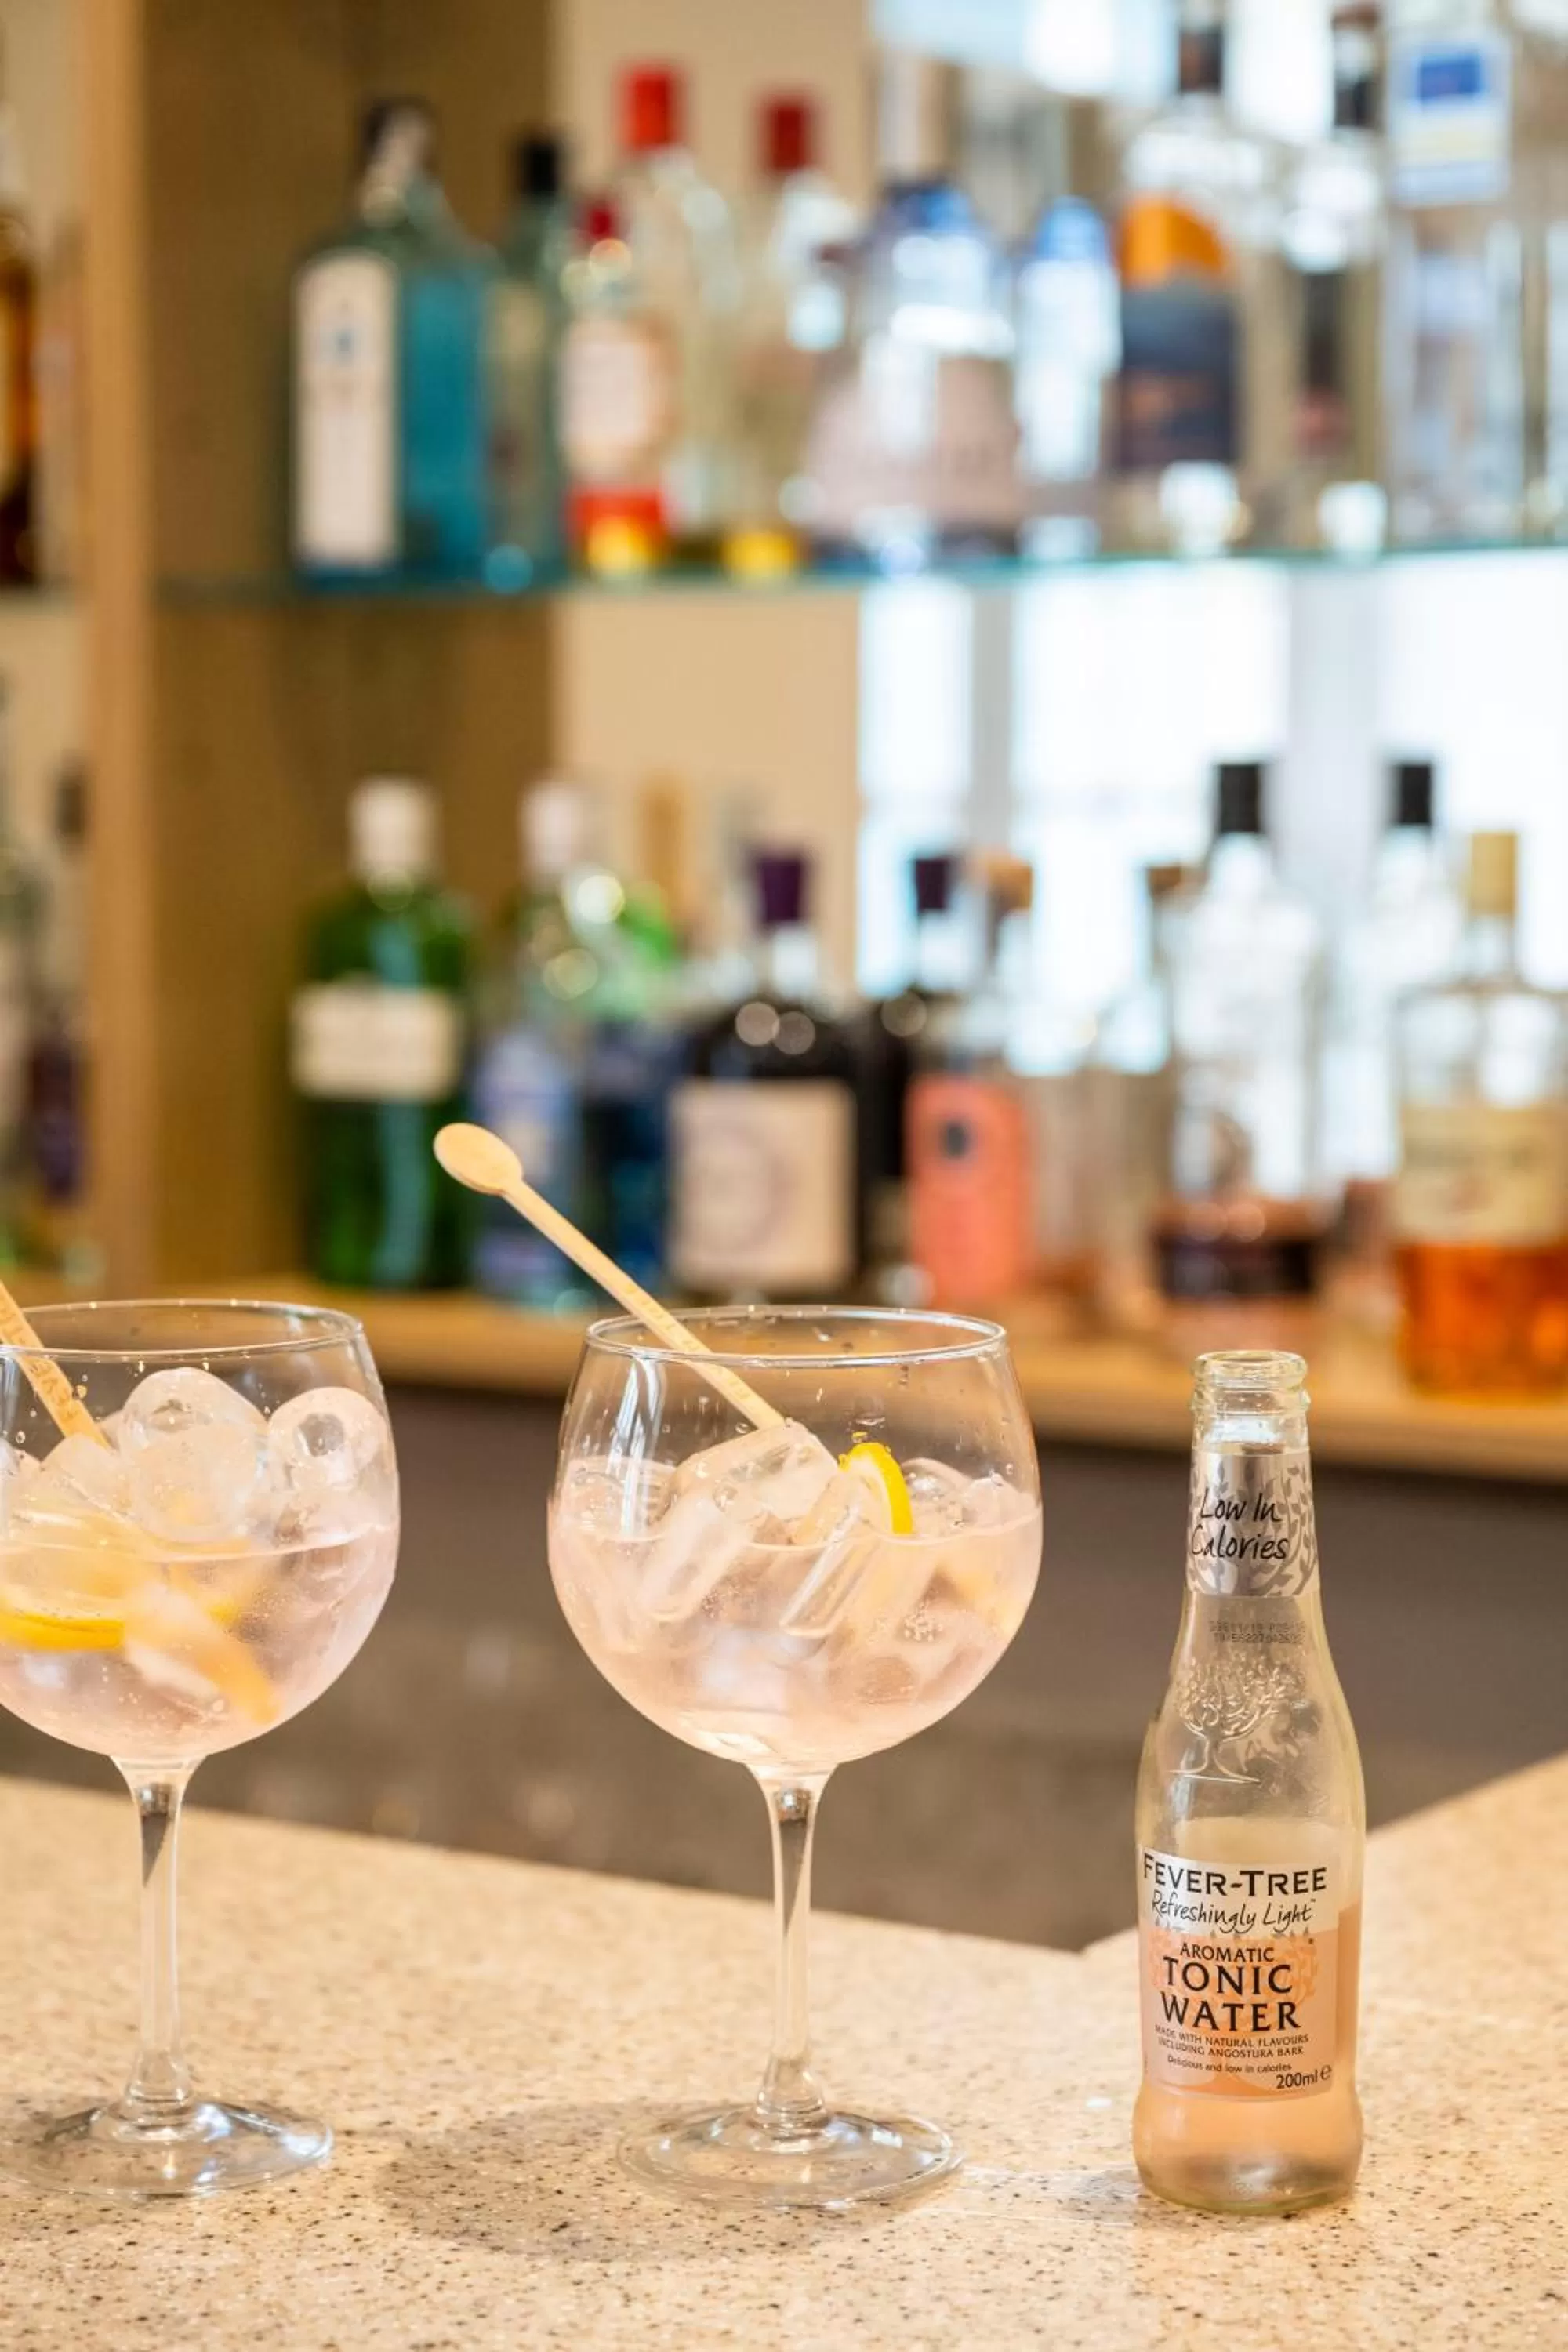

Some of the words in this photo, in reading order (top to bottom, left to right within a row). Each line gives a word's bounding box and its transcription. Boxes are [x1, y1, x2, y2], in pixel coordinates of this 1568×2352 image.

[1200, 1486, 1247, 1521] Low
[1254, 1492, 1282, 1523] In
[1190, 1523, 1290, 1559] Calories
[1143, 1853, 1327, 1896] FEVER-TREE
[1152, 1889, 1257, 1934] Refreshingly
[1179, 1942, 1275, 1962] AROMATIC
[1163, 1956, 1293, 1995] TONIC
[1160, 1991, 1301, 2032] WATER
[1155, 2024, 1176, 2038] MADE
[1178, 2031, 1202, 2044] WITH
[1205, 2036, 1254, 2048] NATURAL
[1258, 2034, 1309, 2048] FLAVOURS
[1158, 2038, 1205, 2056] INCLUDING
[1208, 2048, 1274, 2059] ANGOSTURA
[1277, 2045, 1305, 2056] BARK
[1167, 2054, 1203, 2071] Delicious
[1205, 2063, 1222, 2072] and
[1225, 2063, 1242, 2074] low
[1257, 2063, 1292, 2074] calories
[1276, 2070, 1318, 2089] 200ml
